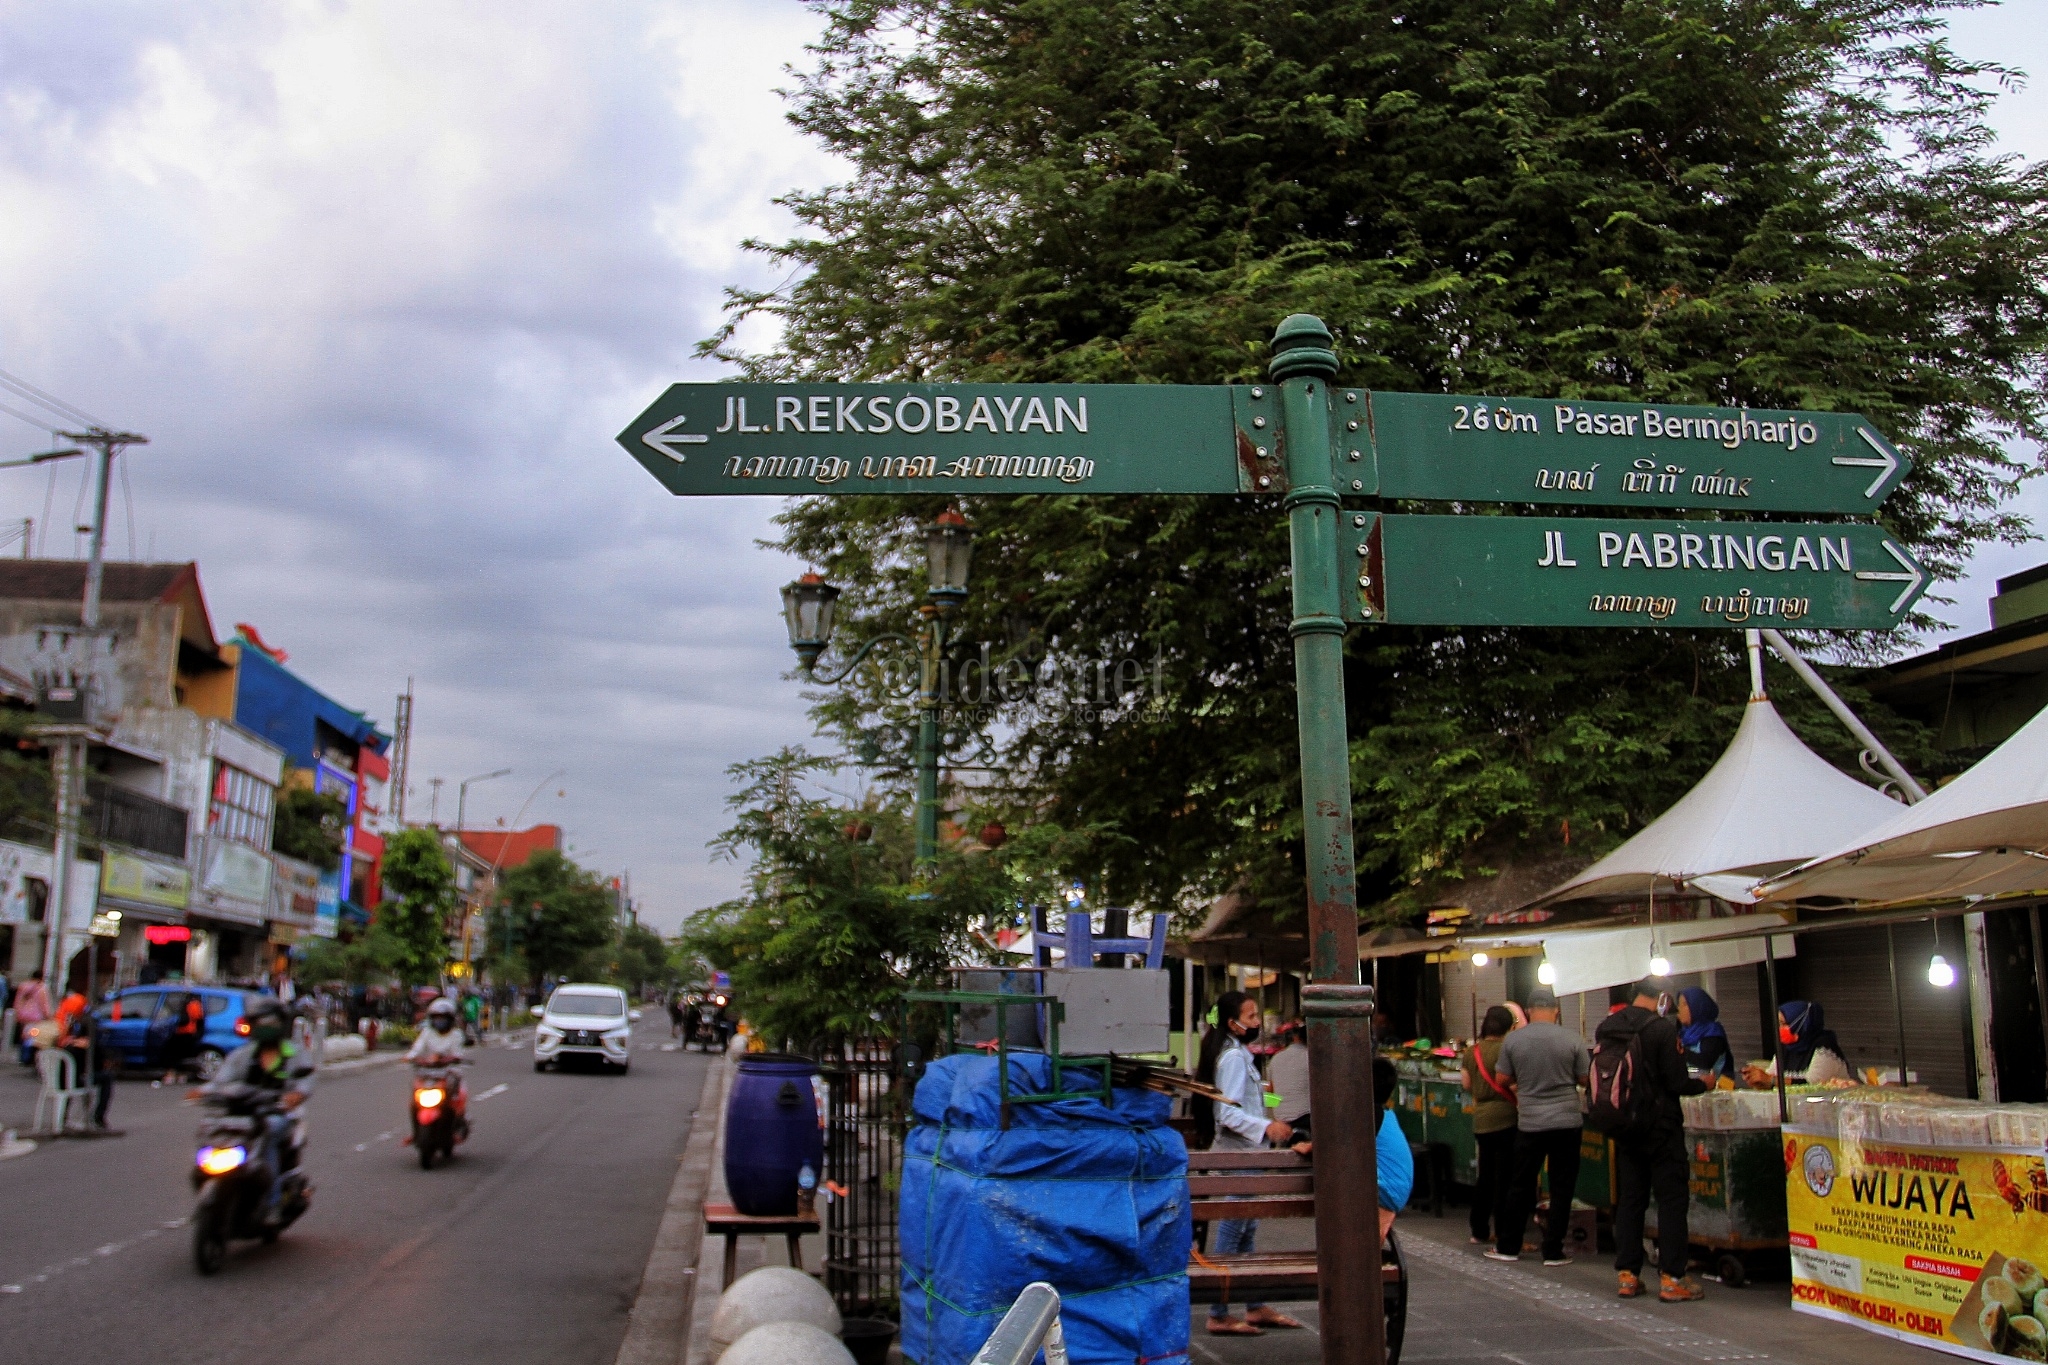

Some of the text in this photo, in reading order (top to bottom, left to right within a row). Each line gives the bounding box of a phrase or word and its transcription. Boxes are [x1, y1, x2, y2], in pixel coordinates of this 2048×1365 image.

[716, 395, 1089, 433] JL.REKSOBAYAN
[1455, 405, 1818, 452] 260m Pasar Beringharjo
[1538, 531, 1851, 572] JL PABRINGAN
[1909, 1154, 1960, 1175] PATHOK
[1851, 1169, 1975, 1220] WIJAYA
[1831, 1207, 1957, 1235] BAKPIA PREMIUM ANEKA RASA
[1838, 1217, 1950, 1244] BAKPIA MADU ANEKA RASA
[1814, 1222, 1842, 1235] BAKPIA
[1843, 1226, 1881, 1243] ORIGINAL
[1890, 1235, 1922, 1250] KERING
[1923, 1239, 1955, 1255] ANEKA
[1957, 1248, 1983, 1261] RASA
[1937, 1263, 1961, 1277] BASAH
[1864, 1302, 1897, 1325] OLEH
[1906, 1311, 1944, 1337] OLEH
